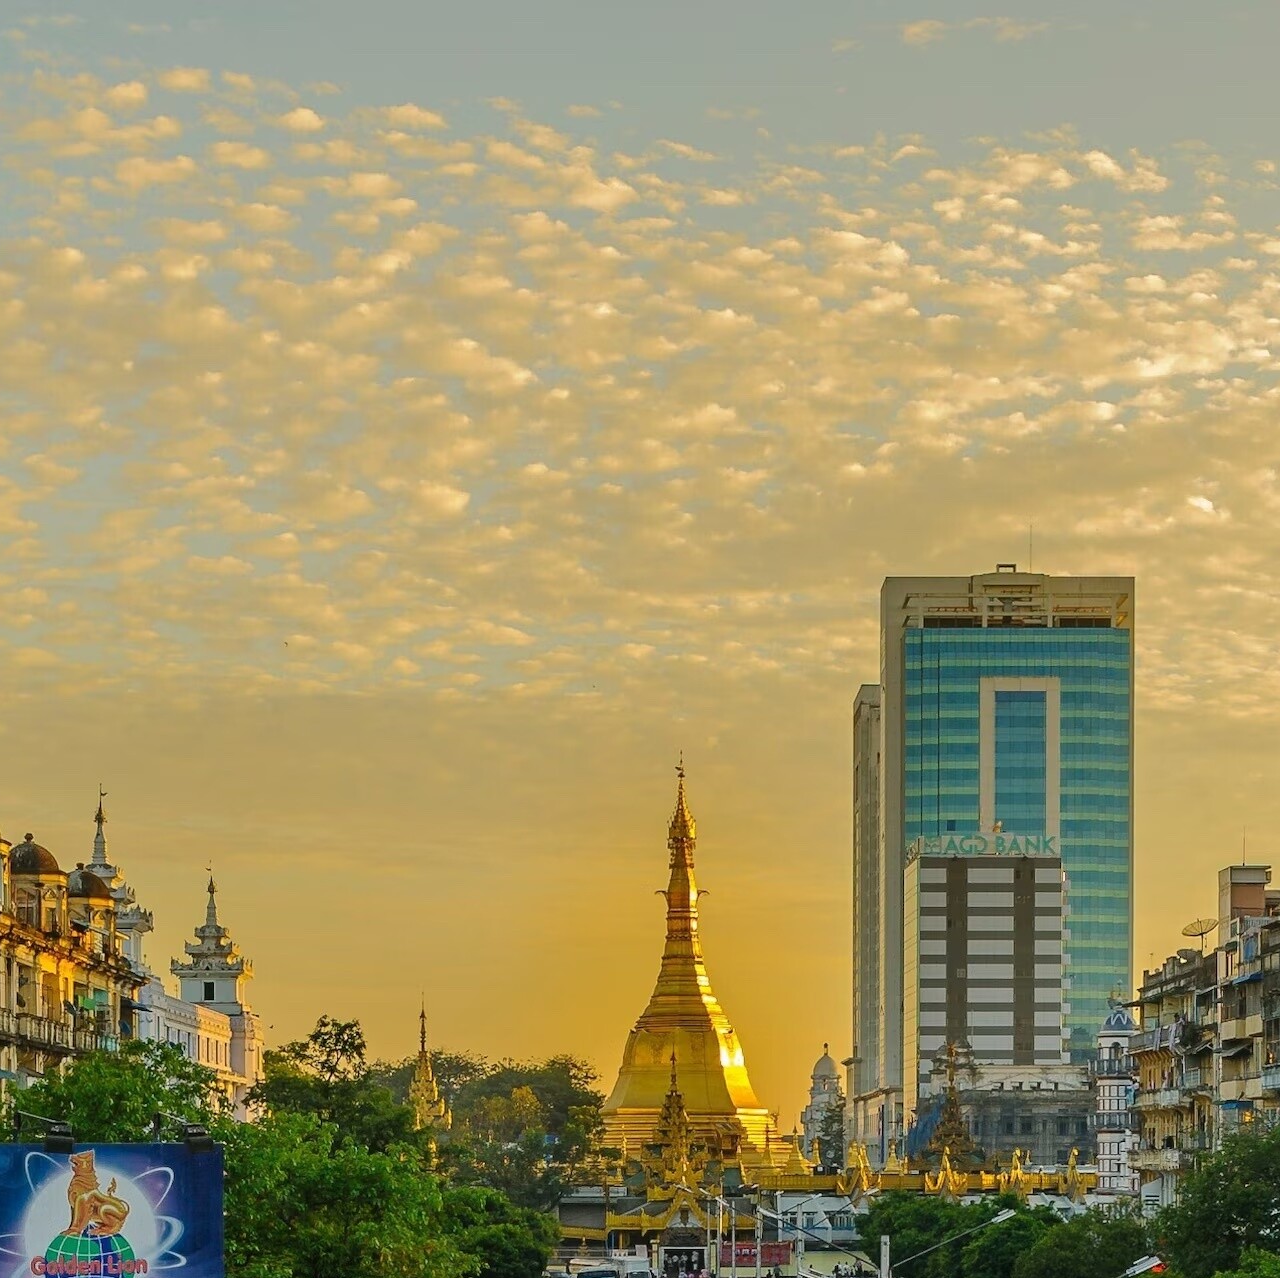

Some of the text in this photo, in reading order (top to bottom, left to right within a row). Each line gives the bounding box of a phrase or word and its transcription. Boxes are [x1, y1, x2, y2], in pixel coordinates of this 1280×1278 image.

[945, 836, 1057, 854] AGD BANK
[30, 1254, 148, 1276] Golden Lion
